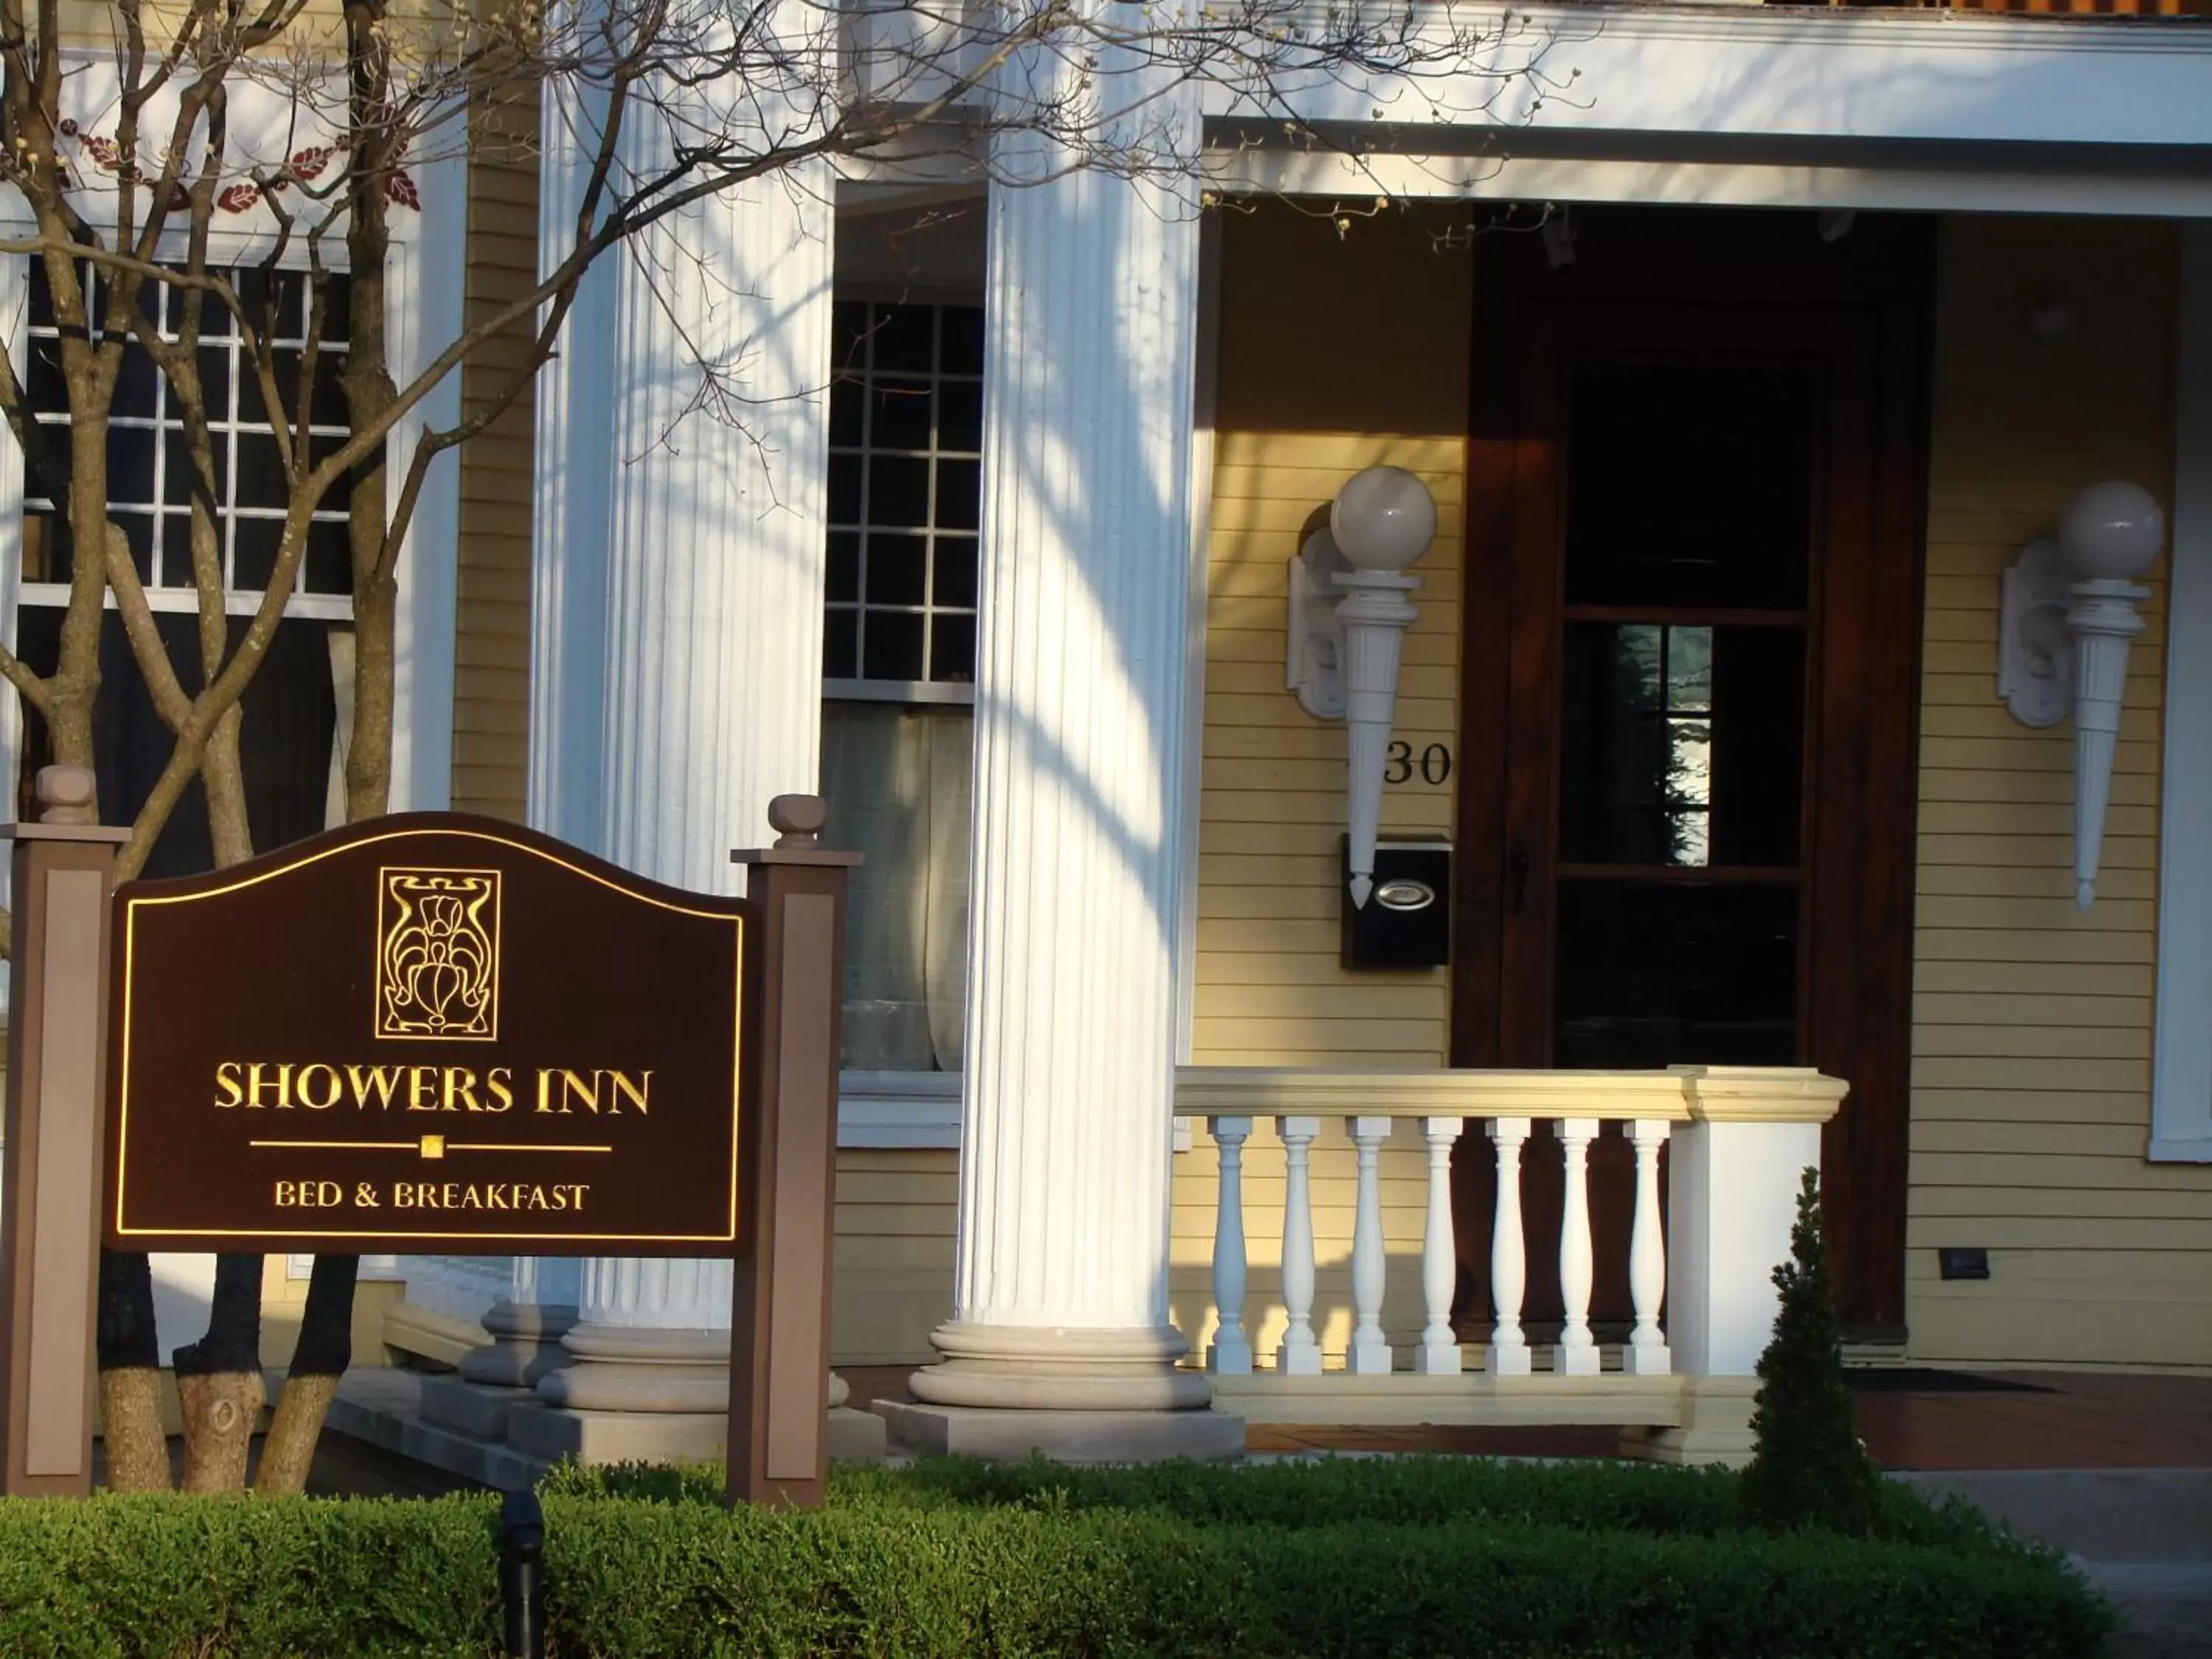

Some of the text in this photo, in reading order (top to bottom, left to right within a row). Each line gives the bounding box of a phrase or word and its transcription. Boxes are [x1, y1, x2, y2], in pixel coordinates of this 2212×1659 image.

[1346, 740, 1451, 785] 30
[214, 1061, 655, 1116] SHOWERS INN
[274, 1180, 591, 1211] BED & BREAKFAST
